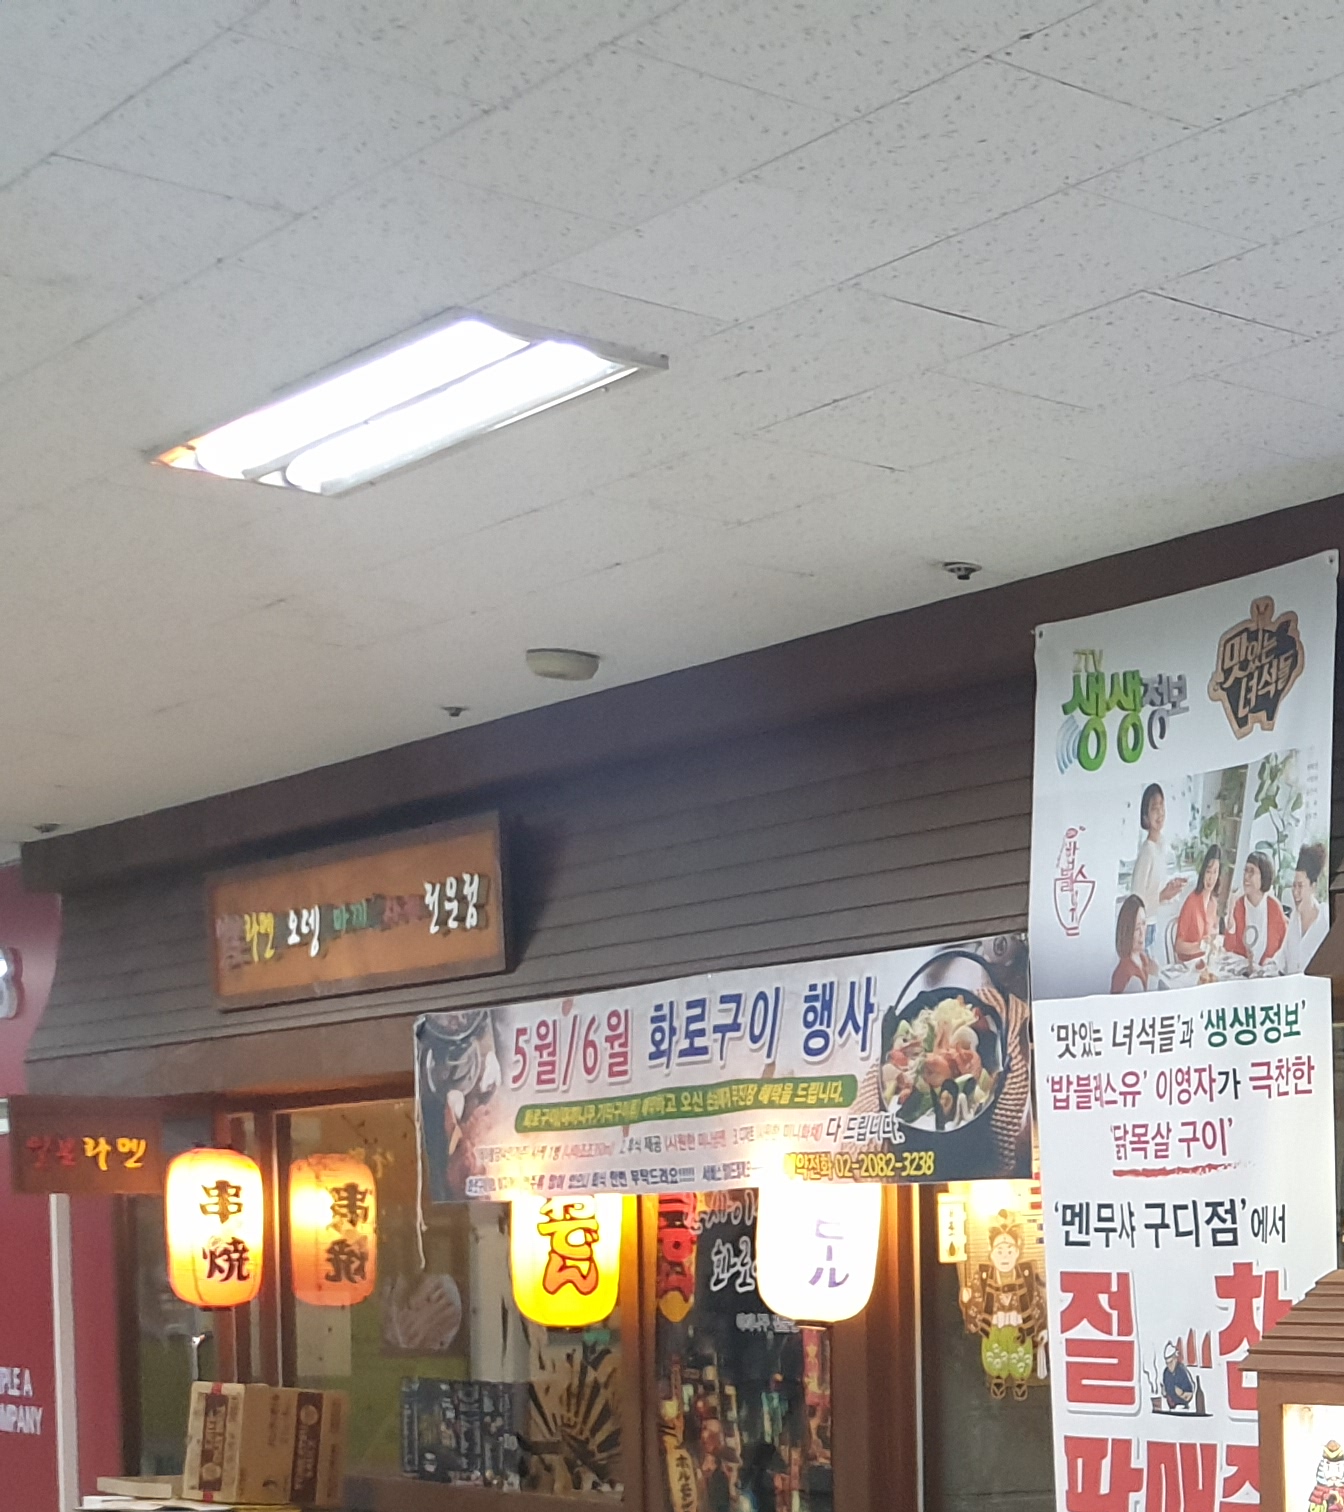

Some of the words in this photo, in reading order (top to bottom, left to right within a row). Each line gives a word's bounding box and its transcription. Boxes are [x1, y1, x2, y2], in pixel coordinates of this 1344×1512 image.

[511, 1008, 633, 1090] 5월/6월
[647, 986, 783, 1067] 화로구이
[801, 975, 878, 1057] 행사
[1155, 1063, 1242, 1106] 이영자가
[1248, 1055, 1315, 1098] 극찬한
[825, 1116, 841, 1143] 다
[1110, 1120, 1172, 1161] '닭목살
[1178, 1117, 1234, 1157] 구이'
[835, 1150, 935, 1178] 02-2082-3238
[1054, 1200, 1136, 1249] '멘무샤
